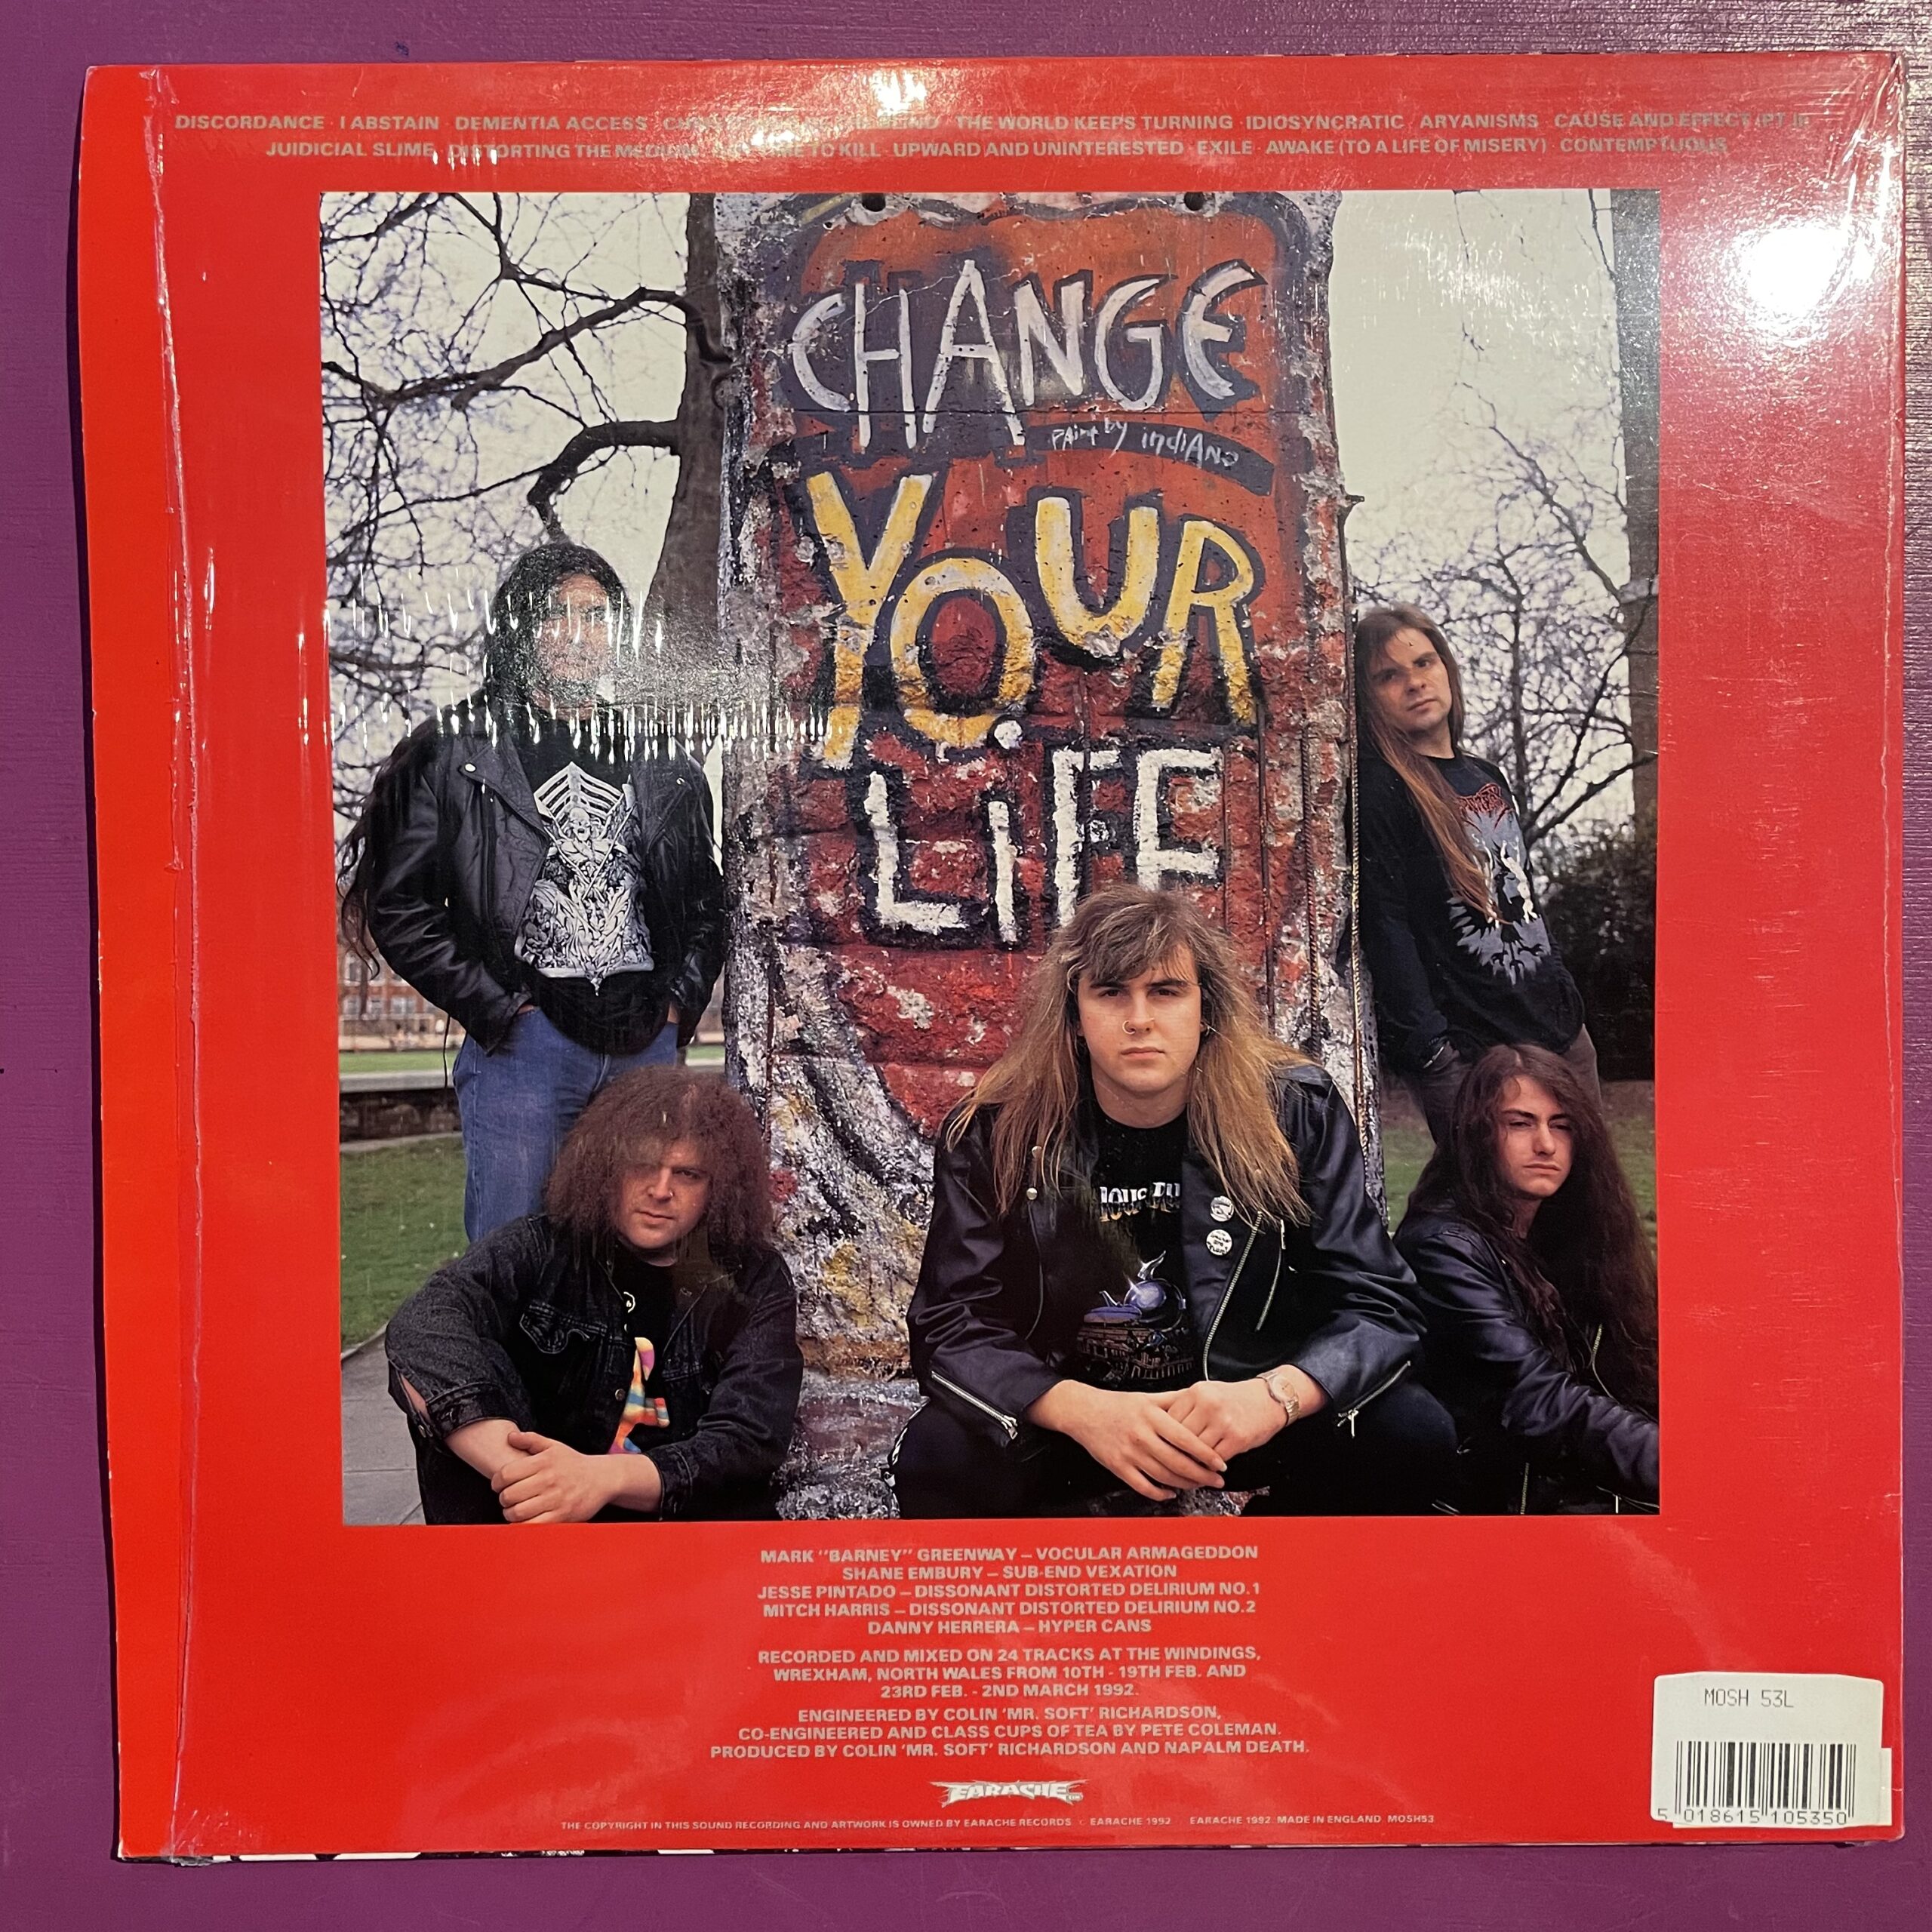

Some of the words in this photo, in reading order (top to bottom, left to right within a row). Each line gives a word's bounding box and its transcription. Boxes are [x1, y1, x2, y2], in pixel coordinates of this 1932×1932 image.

[175, 115, 324, 129] DISCORDANCE
[340, 115, 344, 129] I
[350, 115, 438, 129] ABSTAIN
[456, 115, 559, 129] DEMENTIA
[567, 115, 647, 128] ACCESS
[956, 115, 992, 128] THE
[998, 115, 1069, 128] WORLD
[1075, 115, 1135, 128] KEEPS
[1142, 115, 1232, 128] TURNING
[1246, 115, 1404, 128] IDIOSYNCRATIC
[1420, 115, 1538, 128] ARYANISMS
[1555, 115, 1623, 128] CAUSE
[1629, 115, 1674, 128] AND
[1679, 115, 1749, 128] EFFECT
[266, 143, 367, 157] JUIDICIAL
[373, 143, 434, 157] SLIME
[449, 143, 569, 156] DISTORTING
[577, 143, 611, 156] THE
[811, 142, 835, 155] TO
[839, 142, 881, 155] KILL
[894, 141, 980, 155] UPWARD
[984, 141, 1029, 155] AND
[1033, 141, 1183, 155] UNINTERESTED
[1198, 140, 1252, 155] EXILE
[1266, 140, 1334, 154] AWAKE
[1339, 140, 1370, 154] (TO
[1375, 140, 1388, 154] A
[1392, 140, 1429, 154] LIFE
[1435, 140, 1459, 154] OF
[1464, 140, 1546, 154] MISERY)
[792, 260, 1267, 448] CHANGE
[805, 470, 1266, 759] YOUR
[761, 1550, 814, 1562] MARK
[918, 1548, 1017, 1561] GREENWAY
[1036, 1547, 1121, 1560] VOCULAR
[1127, 1546, 1257, 1558] ARMAGEDDON
[843, 1567, 903, 1580] SHANE
[909, 1567, 983, 1580] EMBURY
[1086, 1565, 1176, 1578] VEXATION
[758, 1586, 811, 1598] JESSE
[817, 1586, 896, 1598] PINTADO
[915, 1584, 1020, 1598] DISSONANT
[1026, 1583, 1125, 1596] DISTORTED
[1131, 1583, 1214, 1595] DELIRIUM
[764, 1604, 820, 1617] MITCH
[825, 1603, 890, 1616] HARRIS
[910, 1602, 1015, 1615] DISSONANT
[1020, 1601, 1119, 1614] DISTORTED
[1124, 1601, 1209, 1614] DELIRIUM
[869, 1621, 933, 1634] DANNY
[938, 1620, 1020, 1633] HERRERA
[1039, 1620, 1097, 1632] HYPER
[1102, 1619, 1151, 1632] CANS
[758, 1651, 855, 1663] RECORDED
[860, 1650, 899, 1662] AND
[904, 1649, 962, 1662] MIXED
[967, 1649, 992, 1661] ON
[998, 1649, 1018, 1661] 24
[1023, 1648, 1094, 1661] TRACKS
[1100, 1648, 1122, 1660] AT
[1127, 1647, 1160, 1660] THE
[1164, 1647, 1260, 1660] WINDINGS,
[774, 1668, 872, 1681] WREXHAM,
[877, 1668, 938, 1680] NORTH
[943, 1666, 1001, 1679] WALES
[1008, 1666, 1057, 1678] FROM
[1063, 1666, 1103, 1678] 10TH
[1119, 1666, 1160, 1678] 19TH
[1165, 1665, 1201, 1678] FEB.
[1207, 1665, 1246, 1677] AND
[881, 1685, 927, 1698] 23RD
[931, 1685, 967, 1697] FEB.
[983, 1684, 1019, 1697] 2ND
[1023, 1684, 1088, 1696] MARCH
[1705, 1688, 1749, 1706] MOSH
[1761, 1690, 1794, 1707] 53L
[799, 1709, 911, 1722] ENGINEERED
[915, 1709, 938, 1721] BY
[944, 1708, 997, 1721] COLIN
[739, 1727, 883, 1740] CO-ENGINEERED
[888, 1727, 927, 1739] AND
[932, 1726, 989, 1738] CLASS
[995, 1725, 1042, 1737] CUPS
[1048, 1724, 1069, 1737] OF
[1074, 1724, 1107, 1737] TEA
[1113, 1724, 1136, 1737] BY
[1141, 1724, 1183, 1736] PETE
[711, 1746, 810, 1758] PRODUCED
[815, 1745, 837, 1757] BY
[843, 1744, 896, 1757] COLIN
[998, 1742, 1115, 1755] RICHARDSON
[1121, 1742, 1159, 1754] AND
[1165, 1741, 1241, 1753] NAPALM
[940, 1780, 1079, 1805] EARACHE
[903, 1820, 943, 1828] OWNED
[1327, 1815, 1381, 1823] ENGLAND
[1657, 1809, 1668, 1820] 5
